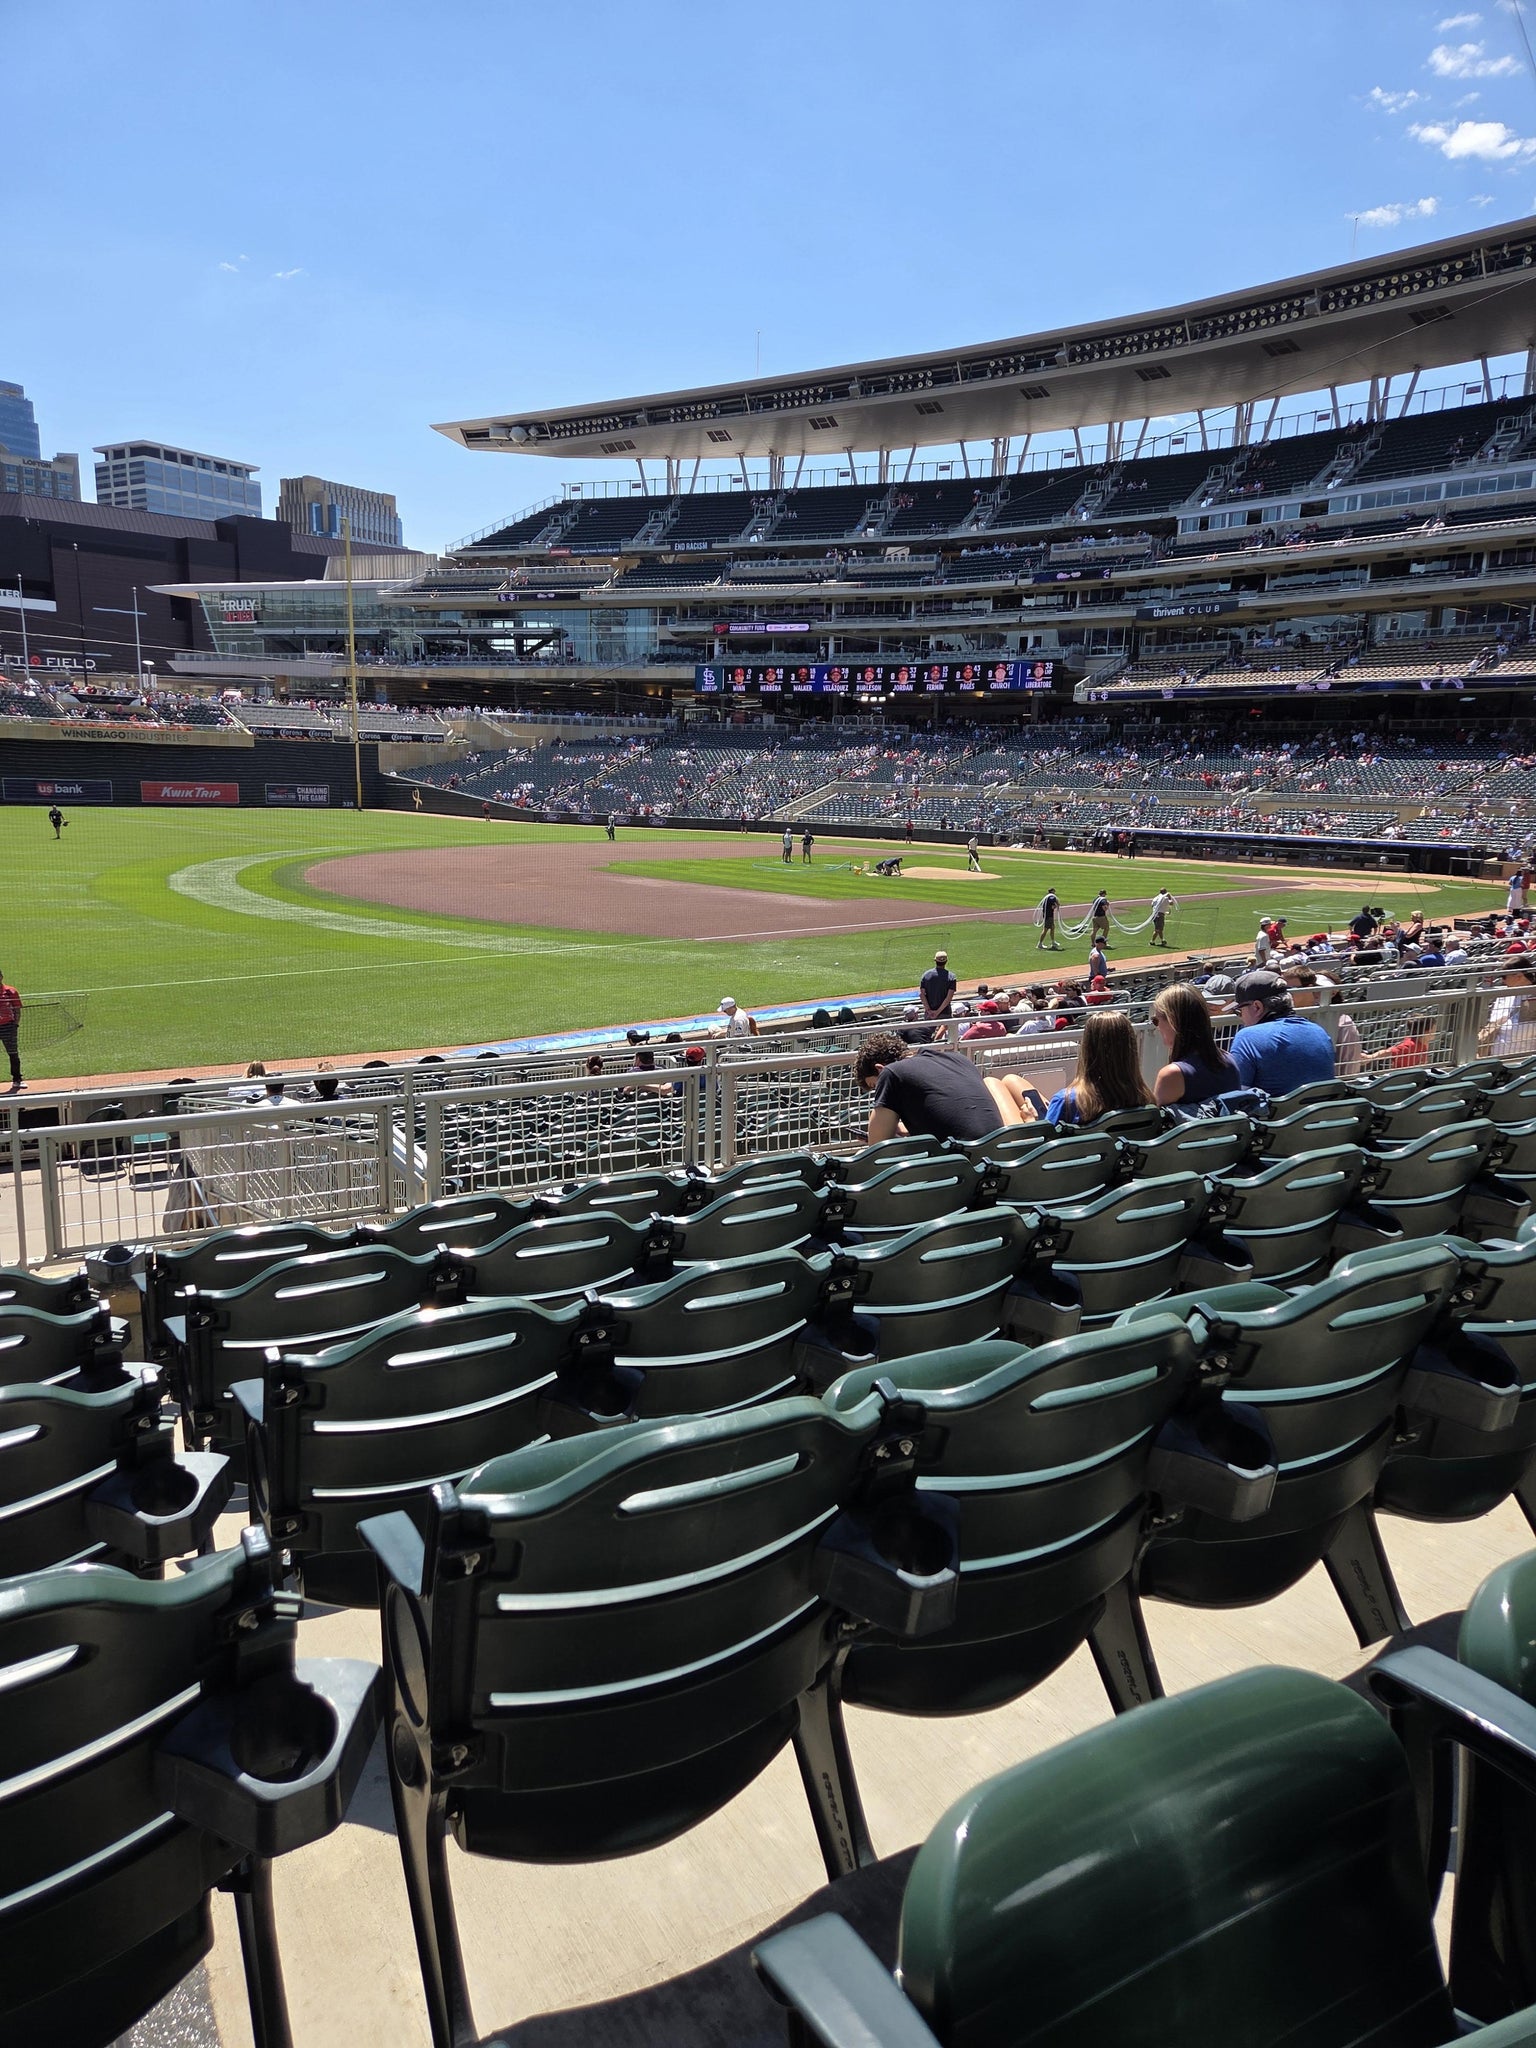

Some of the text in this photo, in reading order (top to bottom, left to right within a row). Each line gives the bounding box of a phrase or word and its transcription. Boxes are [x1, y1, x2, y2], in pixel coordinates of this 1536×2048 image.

[686, 542, 707, 550] RACISM
[221, 600, 256, 611] TRULY
[1153, 605, 1219, 617] thrivent CLUB
[46, 657, 96, 669] FIELD
